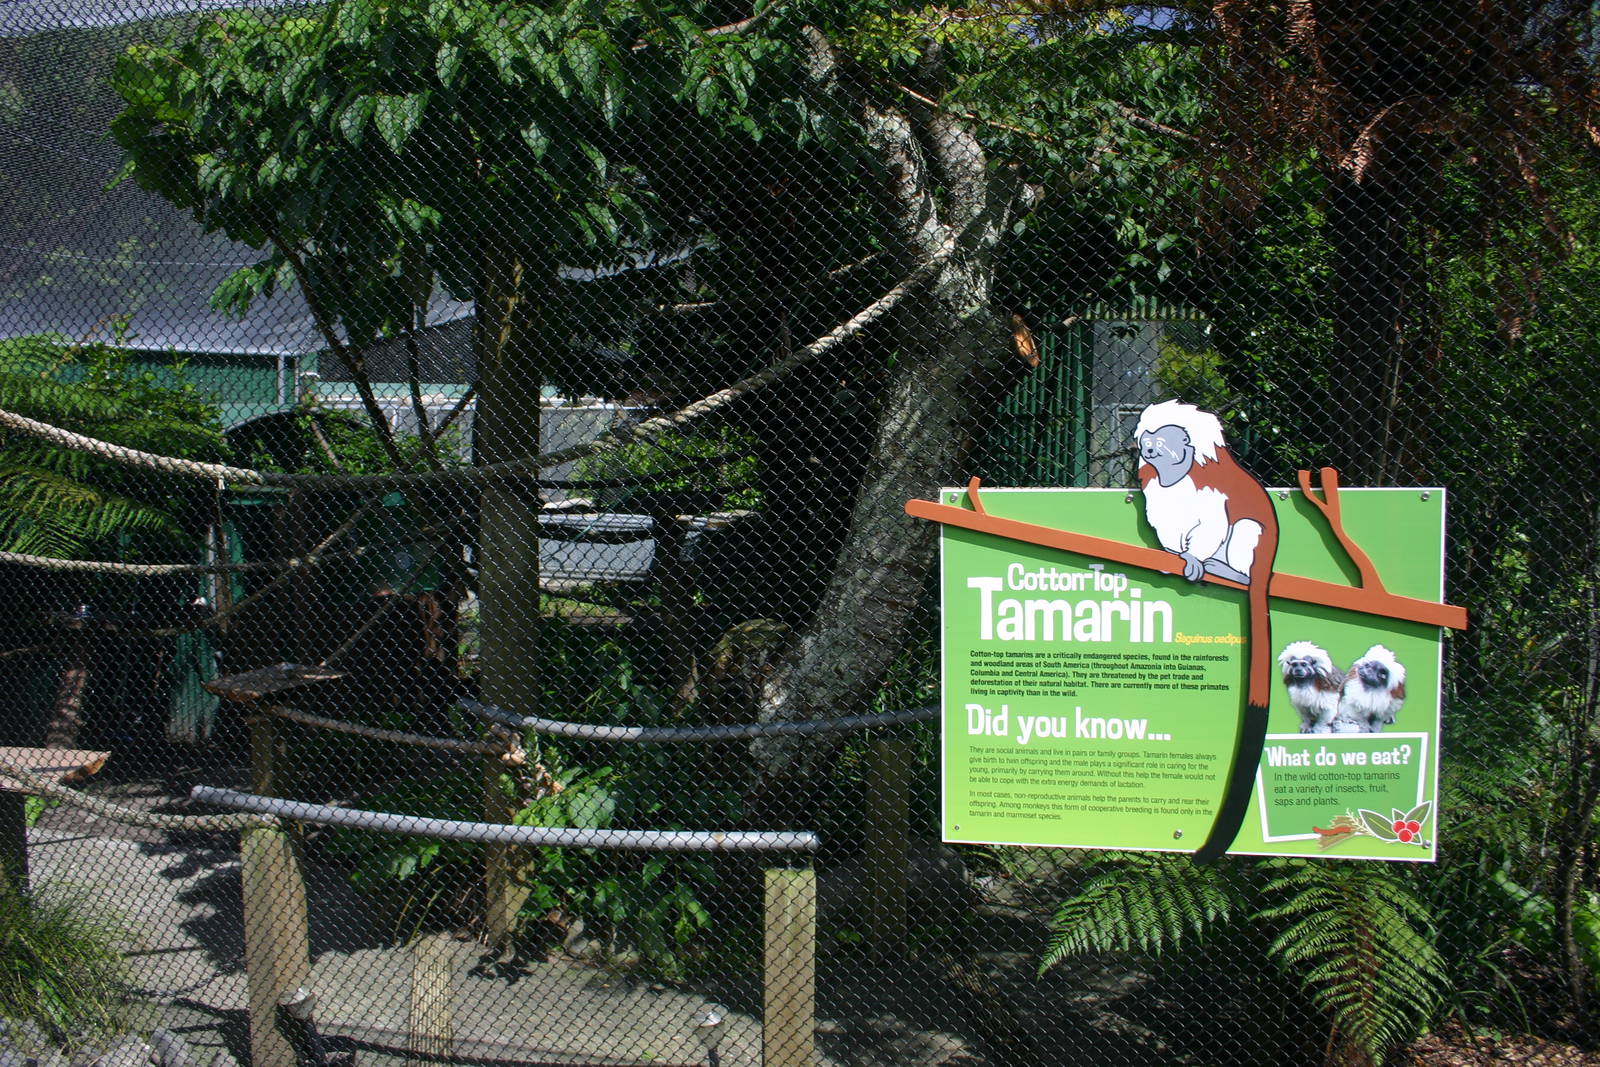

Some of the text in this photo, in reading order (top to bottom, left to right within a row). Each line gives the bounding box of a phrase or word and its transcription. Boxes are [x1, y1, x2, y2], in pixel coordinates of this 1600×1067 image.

[1008, 563, 1128, 598] Cotton-Top
[967, 576, 1173, 643] Tamarin
[970, 650, 1004, 658] Cotton-top
[1053, 652, 1081, 660] critically
[1083, 652, 1121, 660] endangered
[1091, 662, 1128, 670] (throughout
[1040, 670, 1070, 679] America).
[1123, 682, 1152, 690] currently
[1200, 683, 1229, 691] primates
[965, 704, 1171, 744] Did you know...
[1264, 745, 1411, 767] What do we eat?
[1020, 758, 1047, 766] offspring
[1113, 761, 1144, 769] significant
[991, 767, 1018, 775] primarily
[1298, 773, 1316, 781] wild
[1319, 773, 1360, 782] cotton-top
[1296, 785, 1322, 795] variety
[1325, 785, 1334, 793] of
[1336, 784, 1367, 794] insects,
[1370, 784, 1388, 793] fruit,
[1014, 791, 1065, 801] non-reproductive
[969, 800, 997, 809] offspring.
[999, 801, 1021, 809] Among
[1023, 802, 1050, 810] monkeys
[1089, 805, 1123, 813] cooperative
[1125, 806, 1152, 814] breeding
[1274, 799, 1294, 807] saps
[1313, 797, 1339, 807] plants.
[1038, 812, 1062, 820] species.
